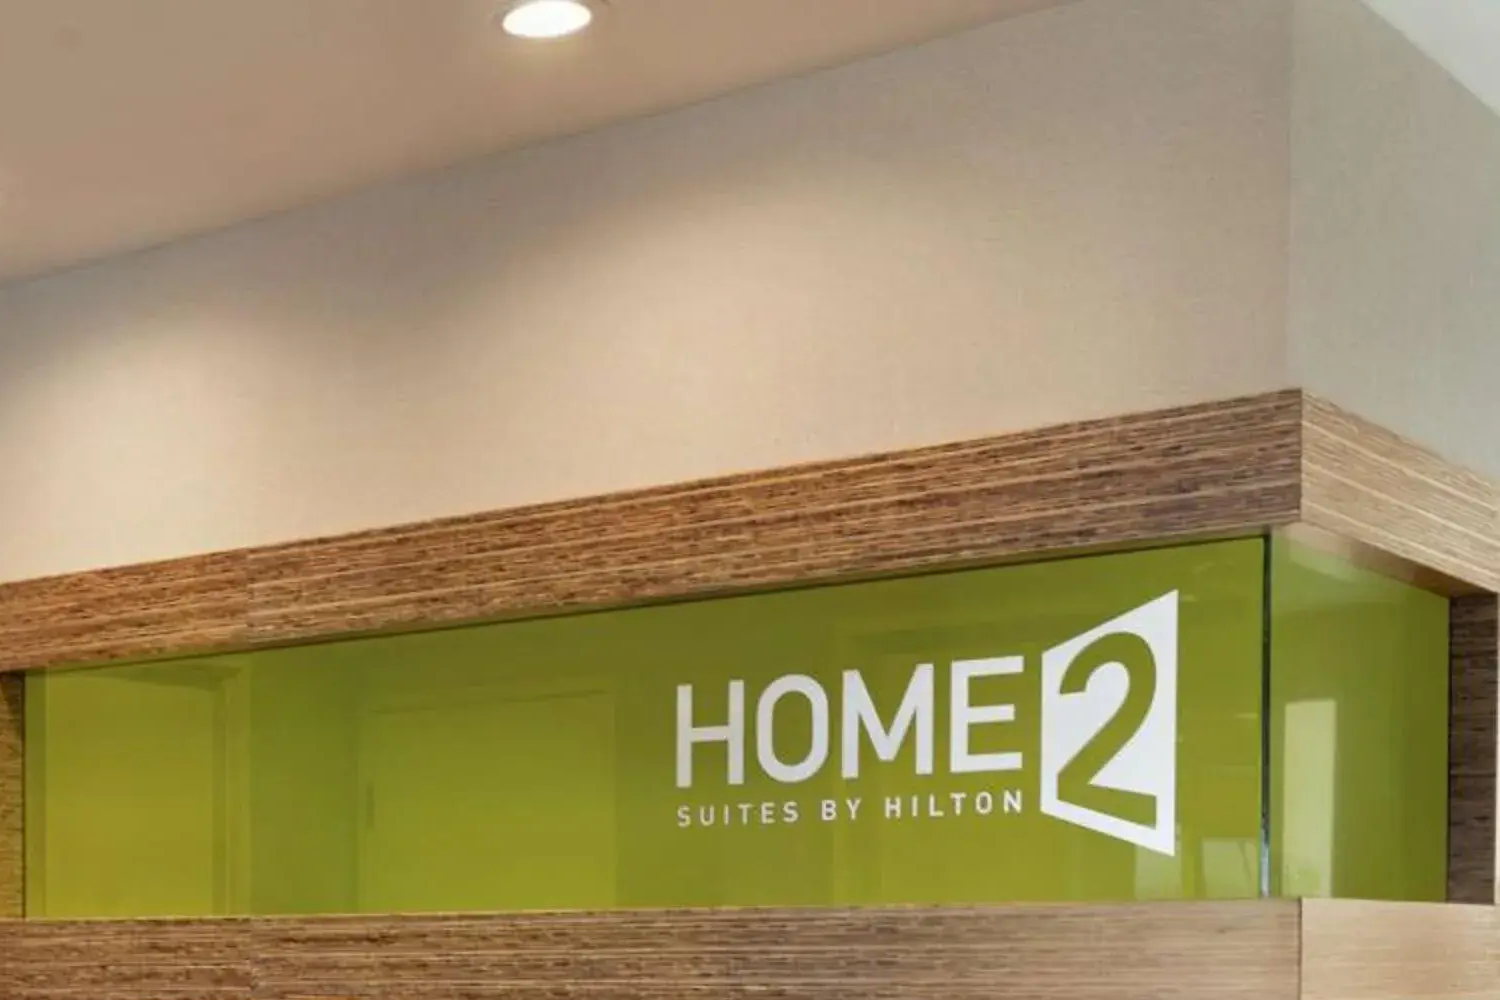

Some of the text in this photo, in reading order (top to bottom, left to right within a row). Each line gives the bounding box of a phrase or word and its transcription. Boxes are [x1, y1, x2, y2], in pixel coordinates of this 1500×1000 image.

[676, 789, 1023, 827] SUITES BY HILTON
